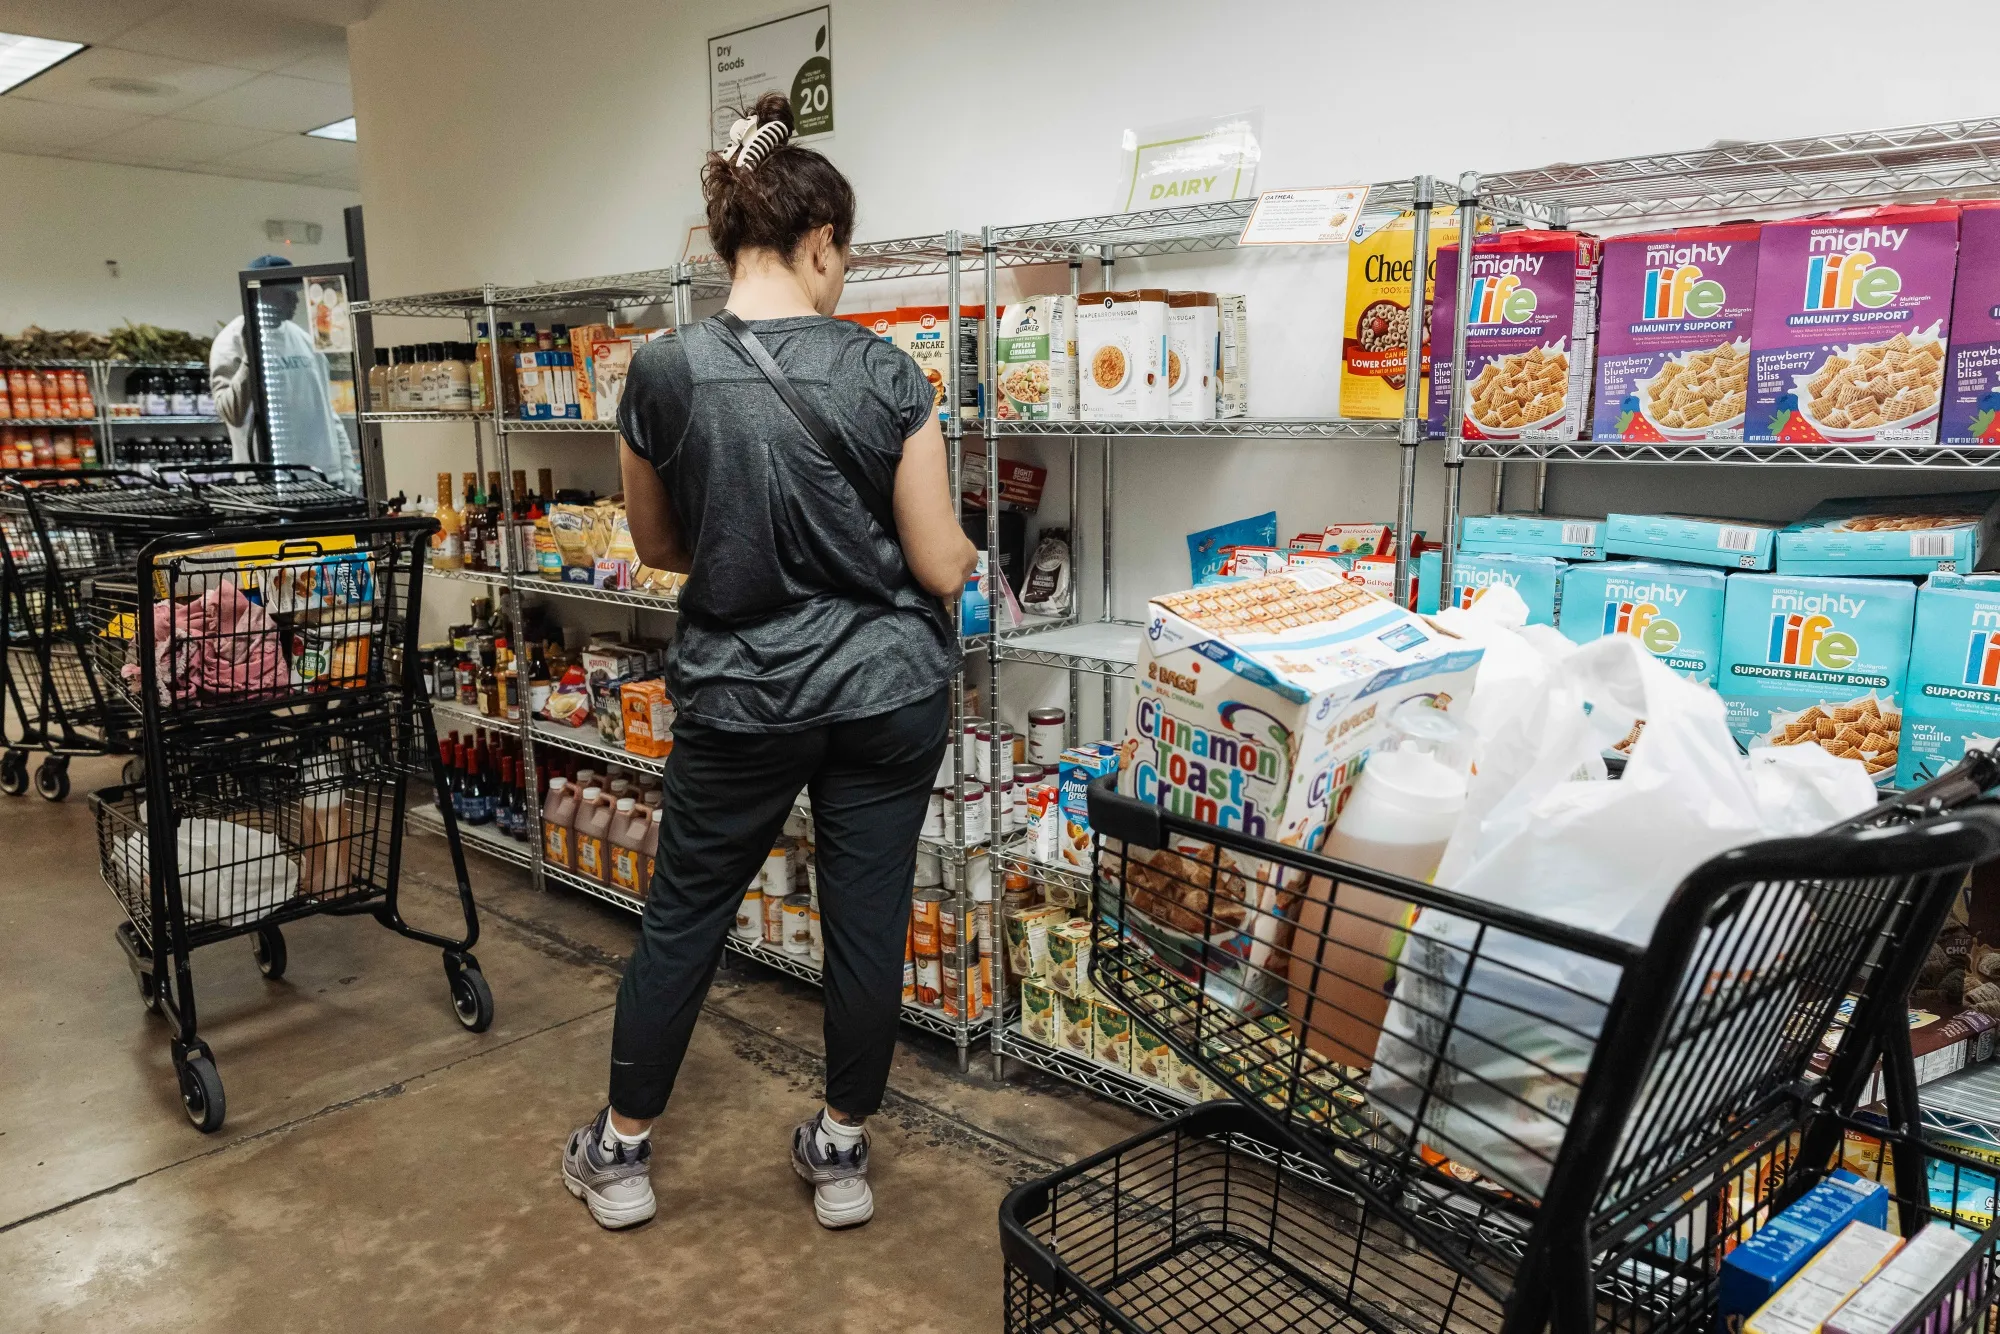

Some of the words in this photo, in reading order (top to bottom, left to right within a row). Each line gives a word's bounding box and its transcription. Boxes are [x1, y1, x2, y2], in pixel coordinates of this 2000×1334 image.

[717, 45, 732, 57] Dry
[718, 57, 745, 73] Goods
[800, 84, 829, 115] 20
[1150, 176, 1217, 200] DAIRY
[1811, 228, 1837, 236] QUAKER
[1809, 225, 1909, 255] mighty
[1646, 243, 1732, 268] mighty
[1473, 253, 1544, 277] mighty
[1803, 251, 1902, 312] life
[1642, 264, 1726, 321] life
[1467, 274, 1538, 325] life
[1789, 313, 1850, 326] IMMUNITY
[1852, 310, 1909, 323] SUPPORT
[1016, 325, 1040, 334] QUAKER
[1467, 328, 1498, 336] MUNITY
[1501, 327, 1542, 336] SUPPORT
[1631, 323, 1682, 334] IMMUNITY
[1683, 320, 1733, 331] SUPPORT
[910, 341, 945, 350] PANCAKE
[1009, 348, 1037, 356] CINNAMON
[1351, 358, 1380, 368] LOWER
[1603, 357, 1654, 368] strawberry
[1756, 351, 1816, 363] strawberry
[1603, 366, 1649, 376] blueberry
[1756, 360, 1810, 372] blueberry
[1603, 375, 1624, 385] bliss
[1756, 371, 1780, 381] bliss
[1957, 368, 1983, 379] bliss
[1434, 376, 1451, 385] bliss
[1014, 467, 1033, 477] EIGHT
[597, 562, 615, 570] JELL-O
[1453, 566, 1522, 588] mighty
[1605, 580, 1688, 607] mighty
[1771, 591, 1866, 619] mighty
[1601, 600, 1682, 655] life
[1765, 612, 1860, 671] life
[1669, 659, 1704, 670] BONES
[1148, 661, 1158, 680] 2
[1159, 665, 1198, 696] BAGS!
[1734, 665, 1792, 678] SUPPORTS
[1794, 671, 1844, 683] HEALTHY
[1847, 676, 1887, 687] BONES
[1925, 685, 1991, 701] SUPPORTS
[1724, 701, 1746, 710] very
[1725, 708, 1759, 717] vanilla
[1912, 722, 1937, 735] very
[1139, 701, 1277, 780] Cinnamon
[1912, 731, 1952, 742] vanilla
[1156, 740, 1244, 807] Toast
[1137, 764, 1266, 839] Crunch
